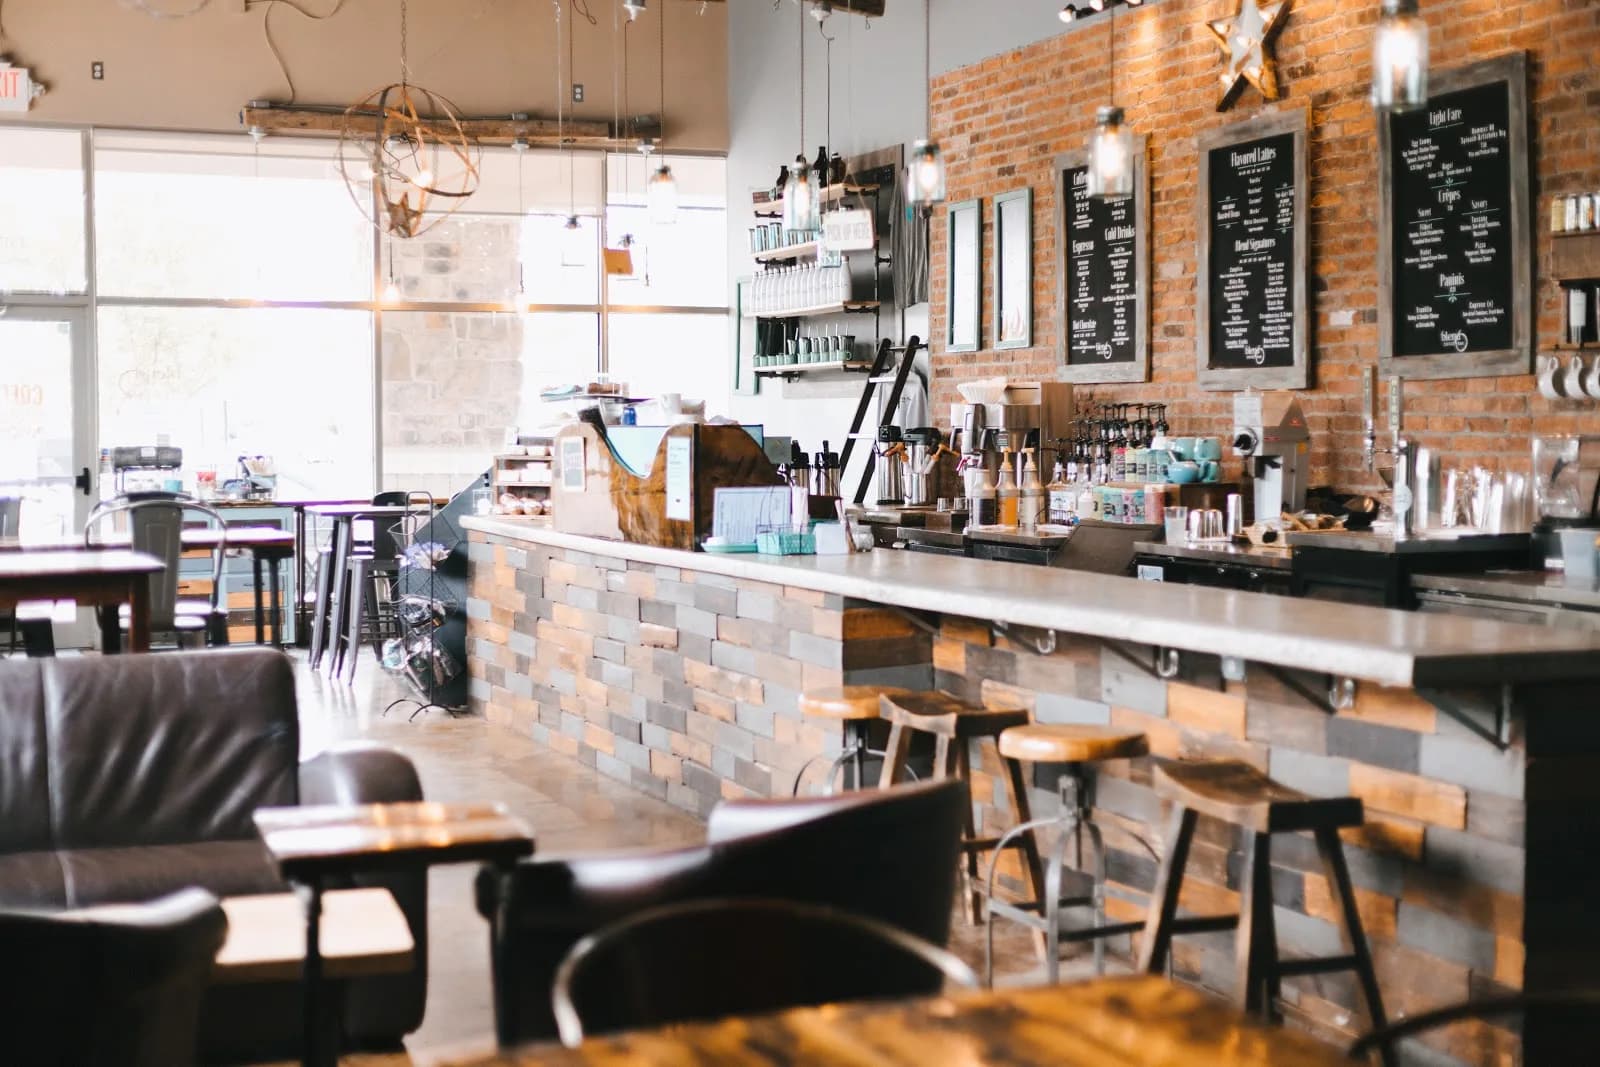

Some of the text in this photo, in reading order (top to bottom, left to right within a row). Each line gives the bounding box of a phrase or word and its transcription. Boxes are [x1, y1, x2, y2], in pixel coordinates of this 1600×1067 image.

[1429, 108, 1462, 126] Light Fare
[1231, 146, 1277, 167] Flavored Lattes
[1104, 224, 1136, 240] Cold Drinks
[1072, 240, 1094, 254] Espresso
[1234, 238, 1276, 252] Blend Signatures
[1439, 272, 1465, 287] Paninis
